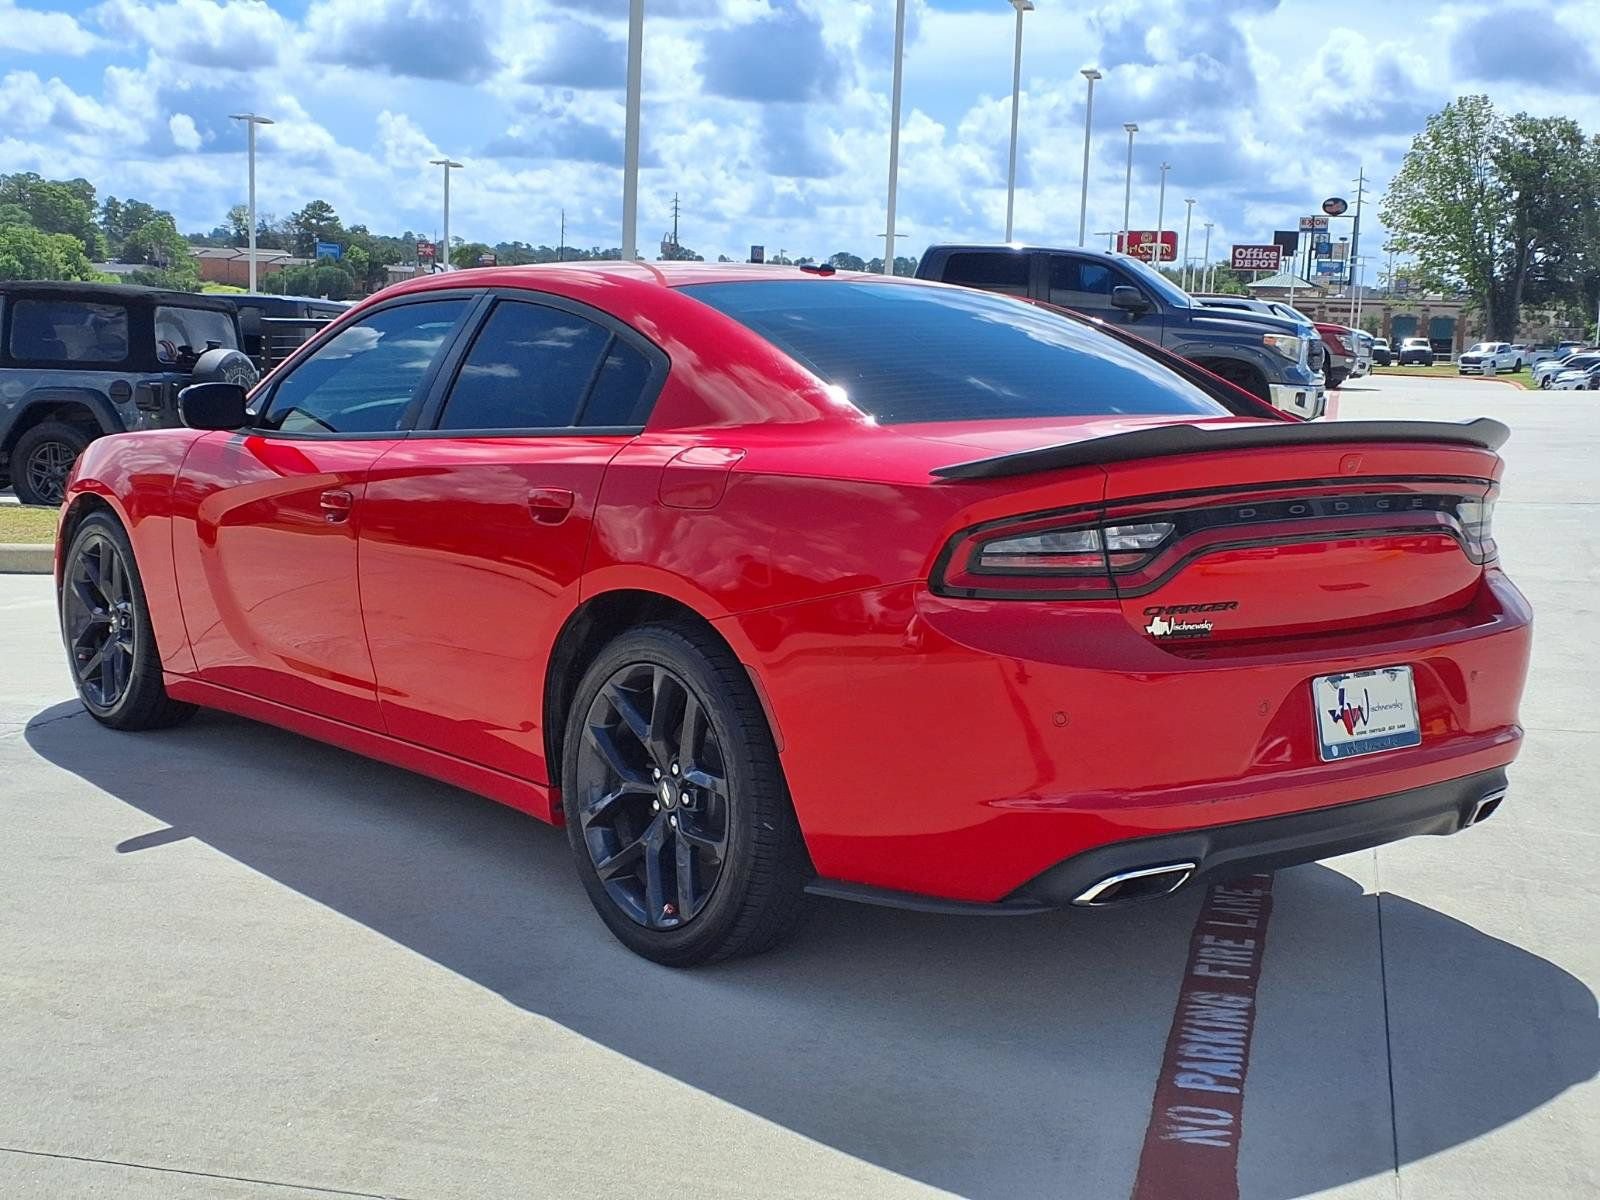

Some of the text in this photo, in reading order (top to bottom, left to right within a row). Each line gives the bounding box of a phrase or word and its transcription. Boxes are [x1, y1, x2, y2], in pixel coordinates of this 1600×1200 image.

[1235, 248, 1278, 259] Office
[1234, 259, 1277, 268] DEPOT
[1239, 498, 1423, 518] DODGE
[1143, 601, 1238, 616] CHARGER
[1159, 885, 1263, 1147] NO PARKING FIRE LANE
